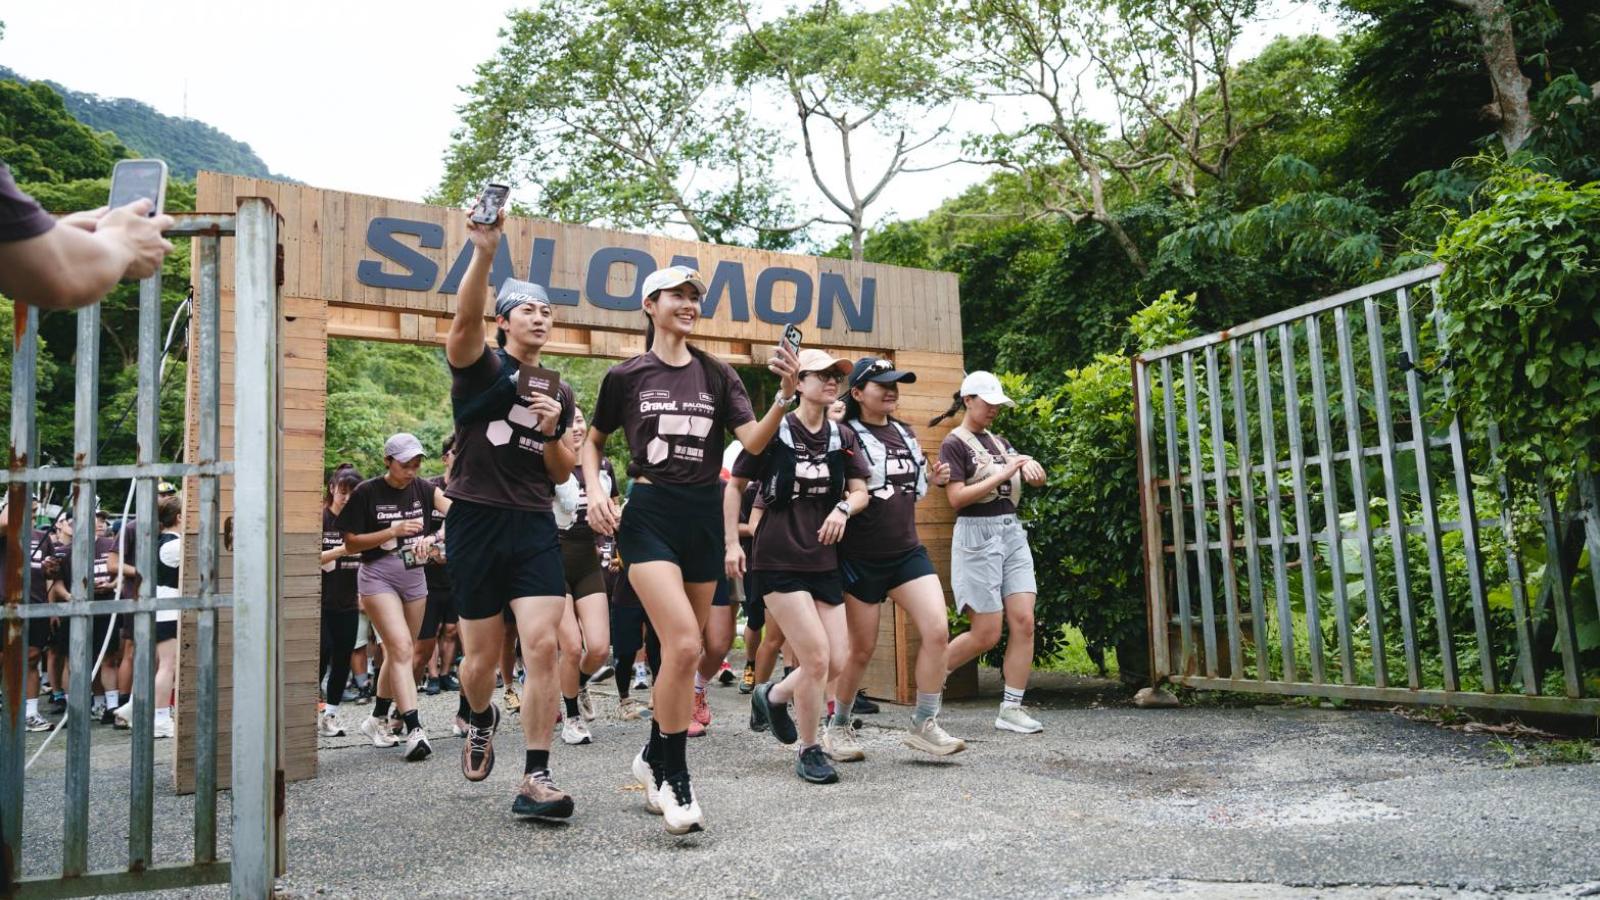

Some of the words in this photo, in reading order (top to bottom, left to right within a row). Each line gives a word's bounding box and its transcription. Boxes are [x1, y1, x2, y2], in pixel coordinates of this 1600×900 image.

[357, 217, 876, 332] SALOMON
[640, 401, 678, 413] Gravel.
[682, 402, 715, 411] SALOMON
